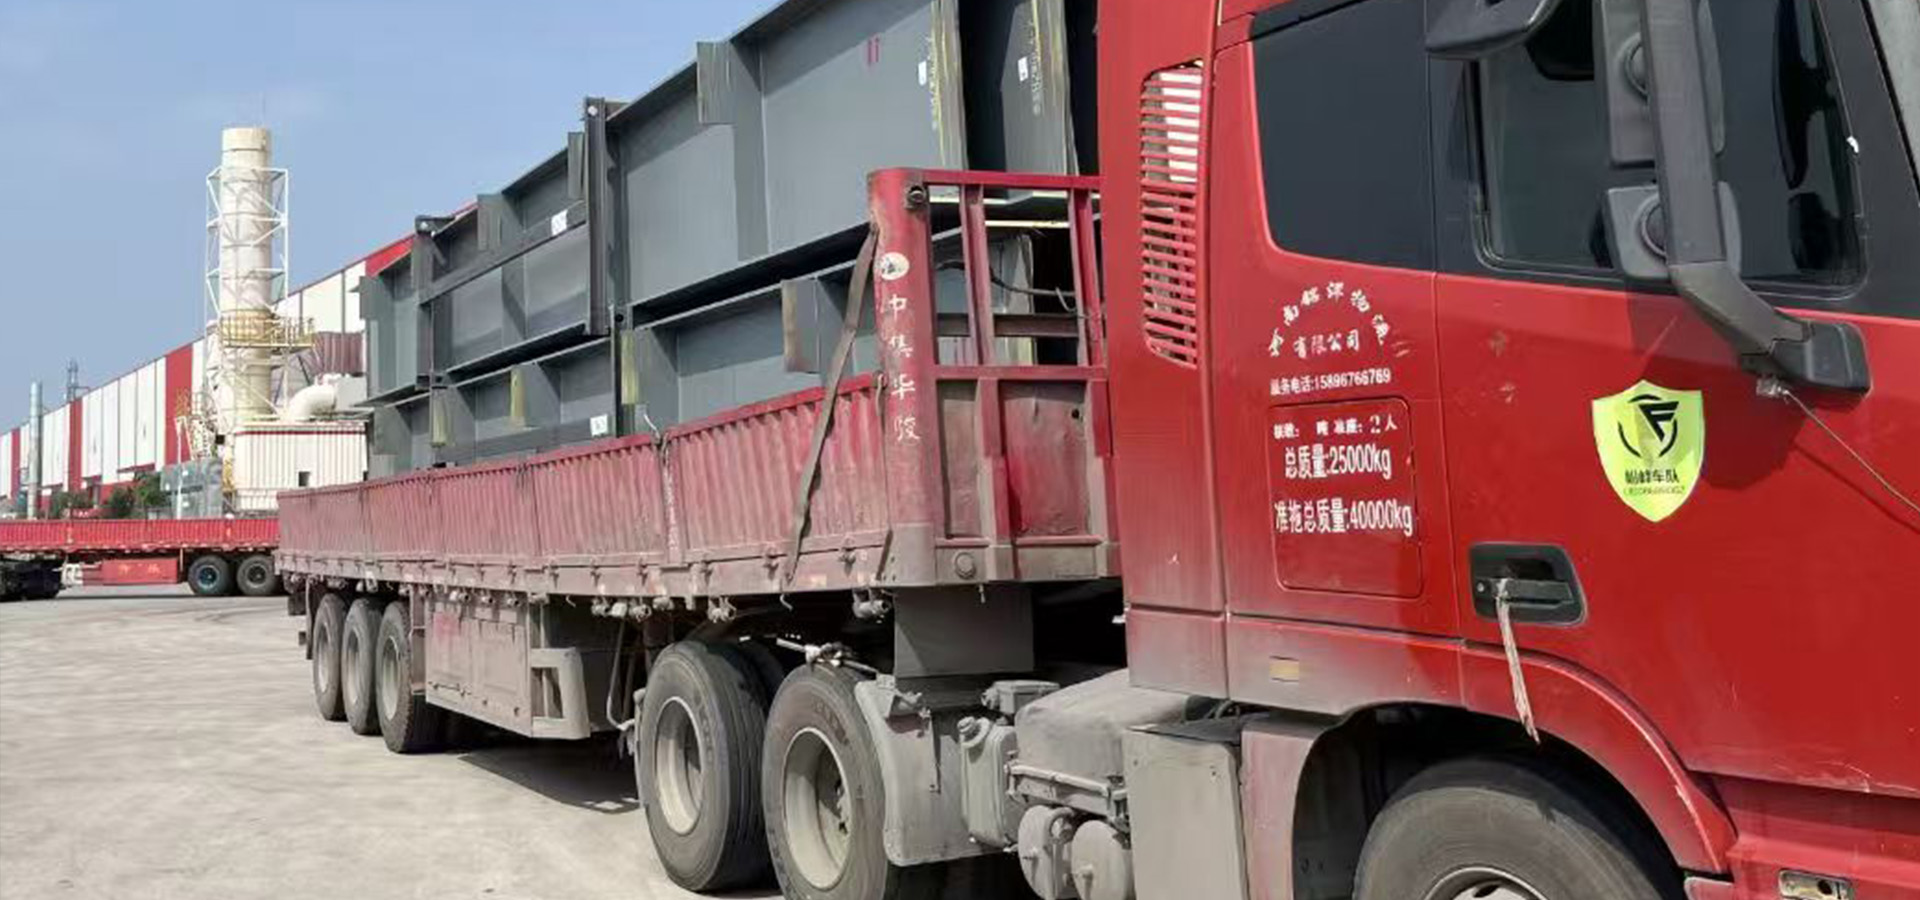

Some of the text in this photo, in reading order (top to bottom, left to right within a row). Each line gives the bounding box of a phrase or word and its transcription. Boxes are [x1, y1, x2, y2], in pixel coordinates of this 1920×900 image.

[1293, 329, 1360, 358] 有限公司
[1285, 443, 1392, 480] 总质量:25000kg
[1274, 497, 1413, 537] 准拖总质量:40000kg
